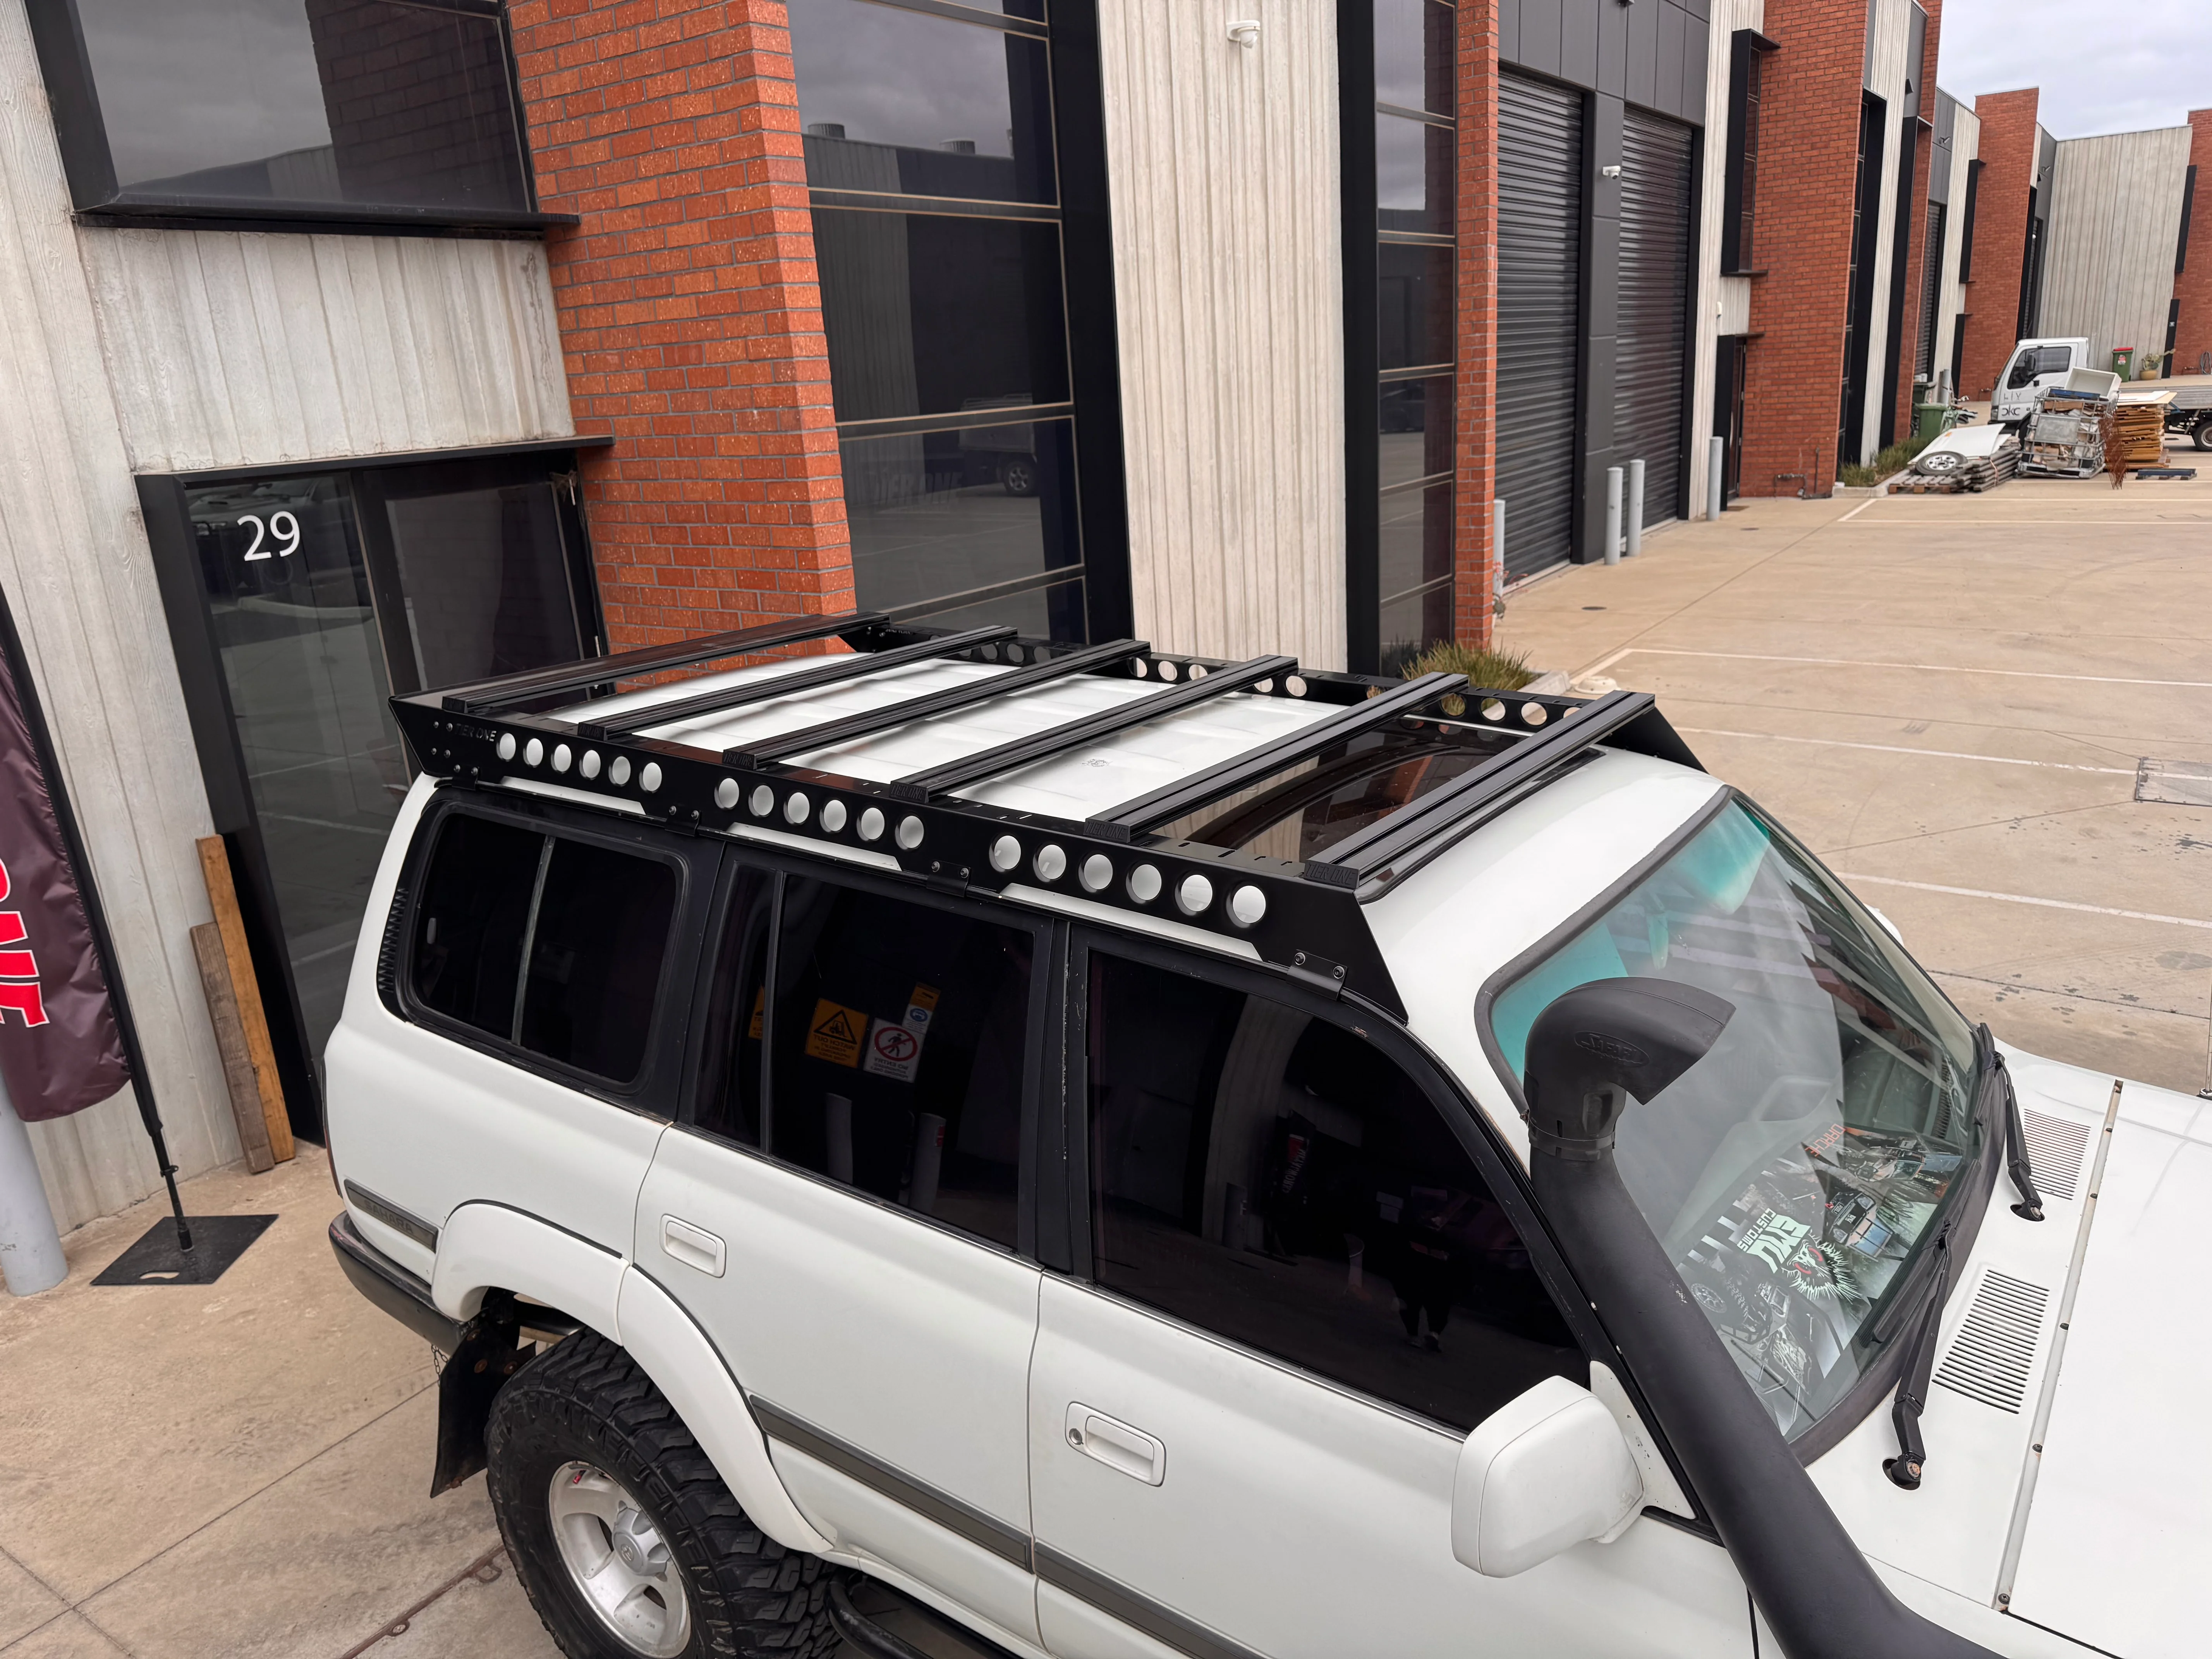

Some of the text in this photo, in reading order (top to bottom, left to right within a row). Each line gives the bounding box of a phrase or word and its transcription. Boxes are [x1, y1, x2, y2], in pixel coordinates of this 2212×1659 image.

[237, 511, 301, 562] 29
[454, 723, 497, 742] TIER ONE
[890, 783, 925, 800] TIER ONE
[1085, 821, 1128, 840] TIER ONE
[1305, 862, 1355, 885] TIER ONE
[1580, 1033, 1638, 1060] SAFARI
[1805, 1123, 1846, 1157] DARCHE
[364, 1199, 414, 1234] SAHARA
[1737, 1208, 1776, 1252] CUSTOMS
[1747, 1214, 1811, 1273] EMU
